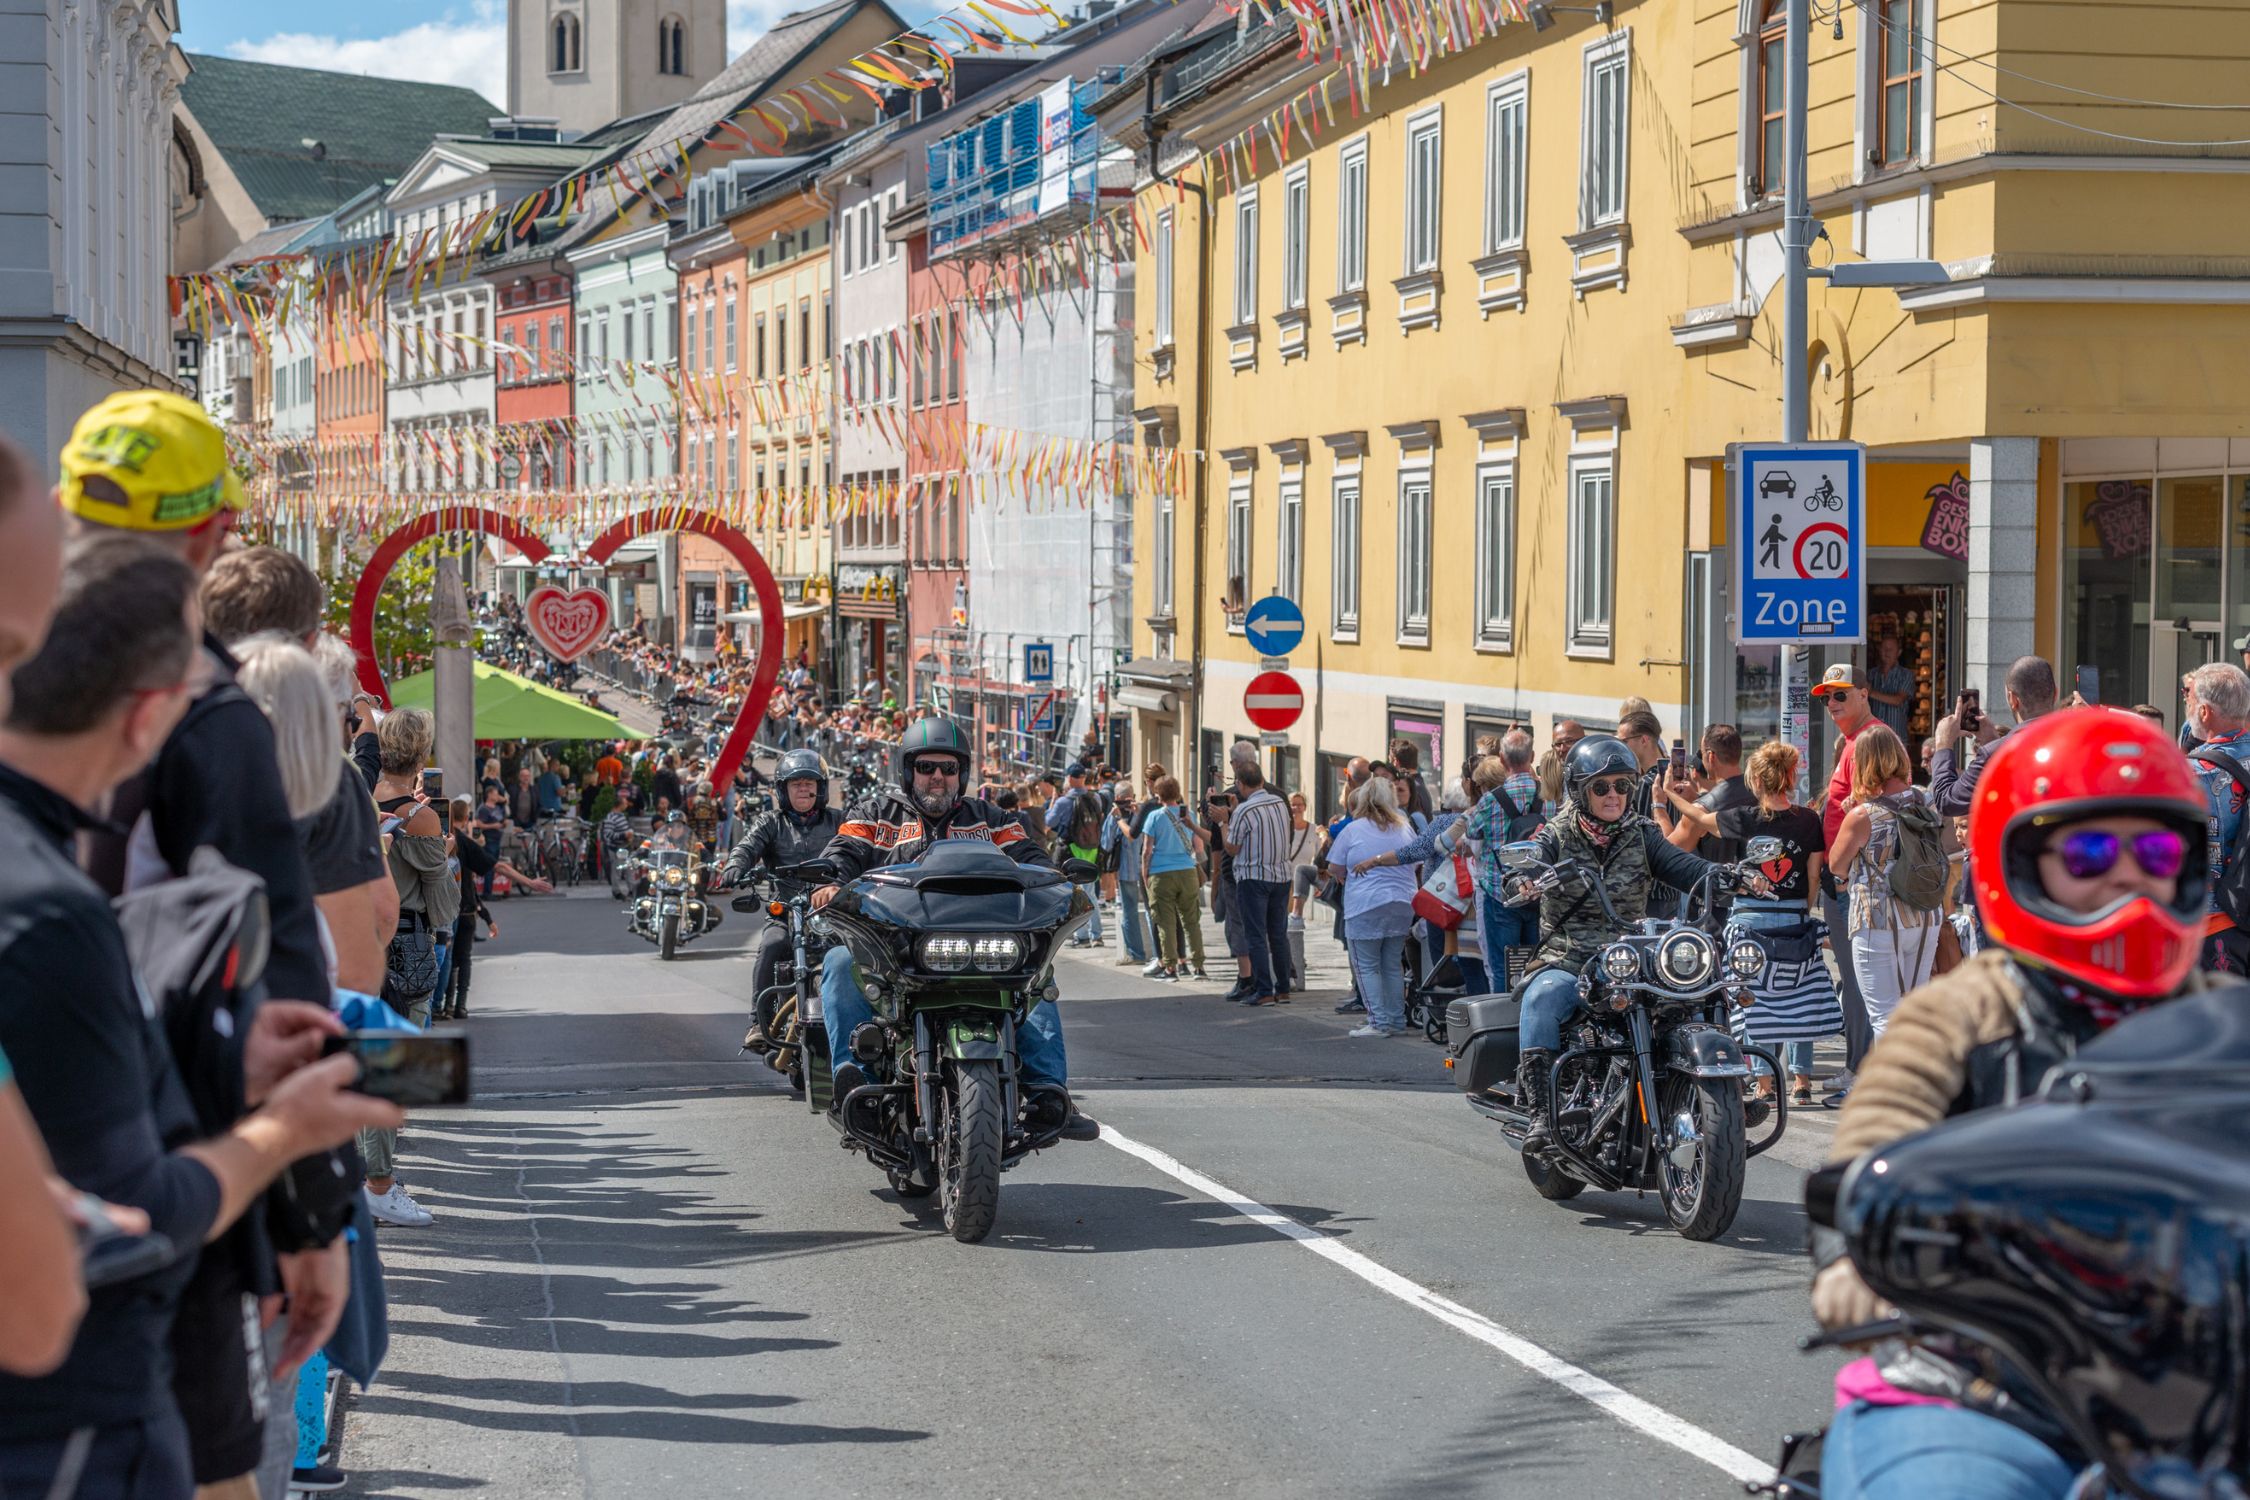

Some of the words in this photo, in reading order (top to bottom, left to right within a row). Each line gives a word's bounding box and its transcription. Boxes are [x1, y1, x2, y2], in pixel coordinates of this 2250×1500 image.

[1810, 541, 1841, 570] 20
[1755, 592, 1847, 625] Zone
[875, 825, 918, 845] HAREY
